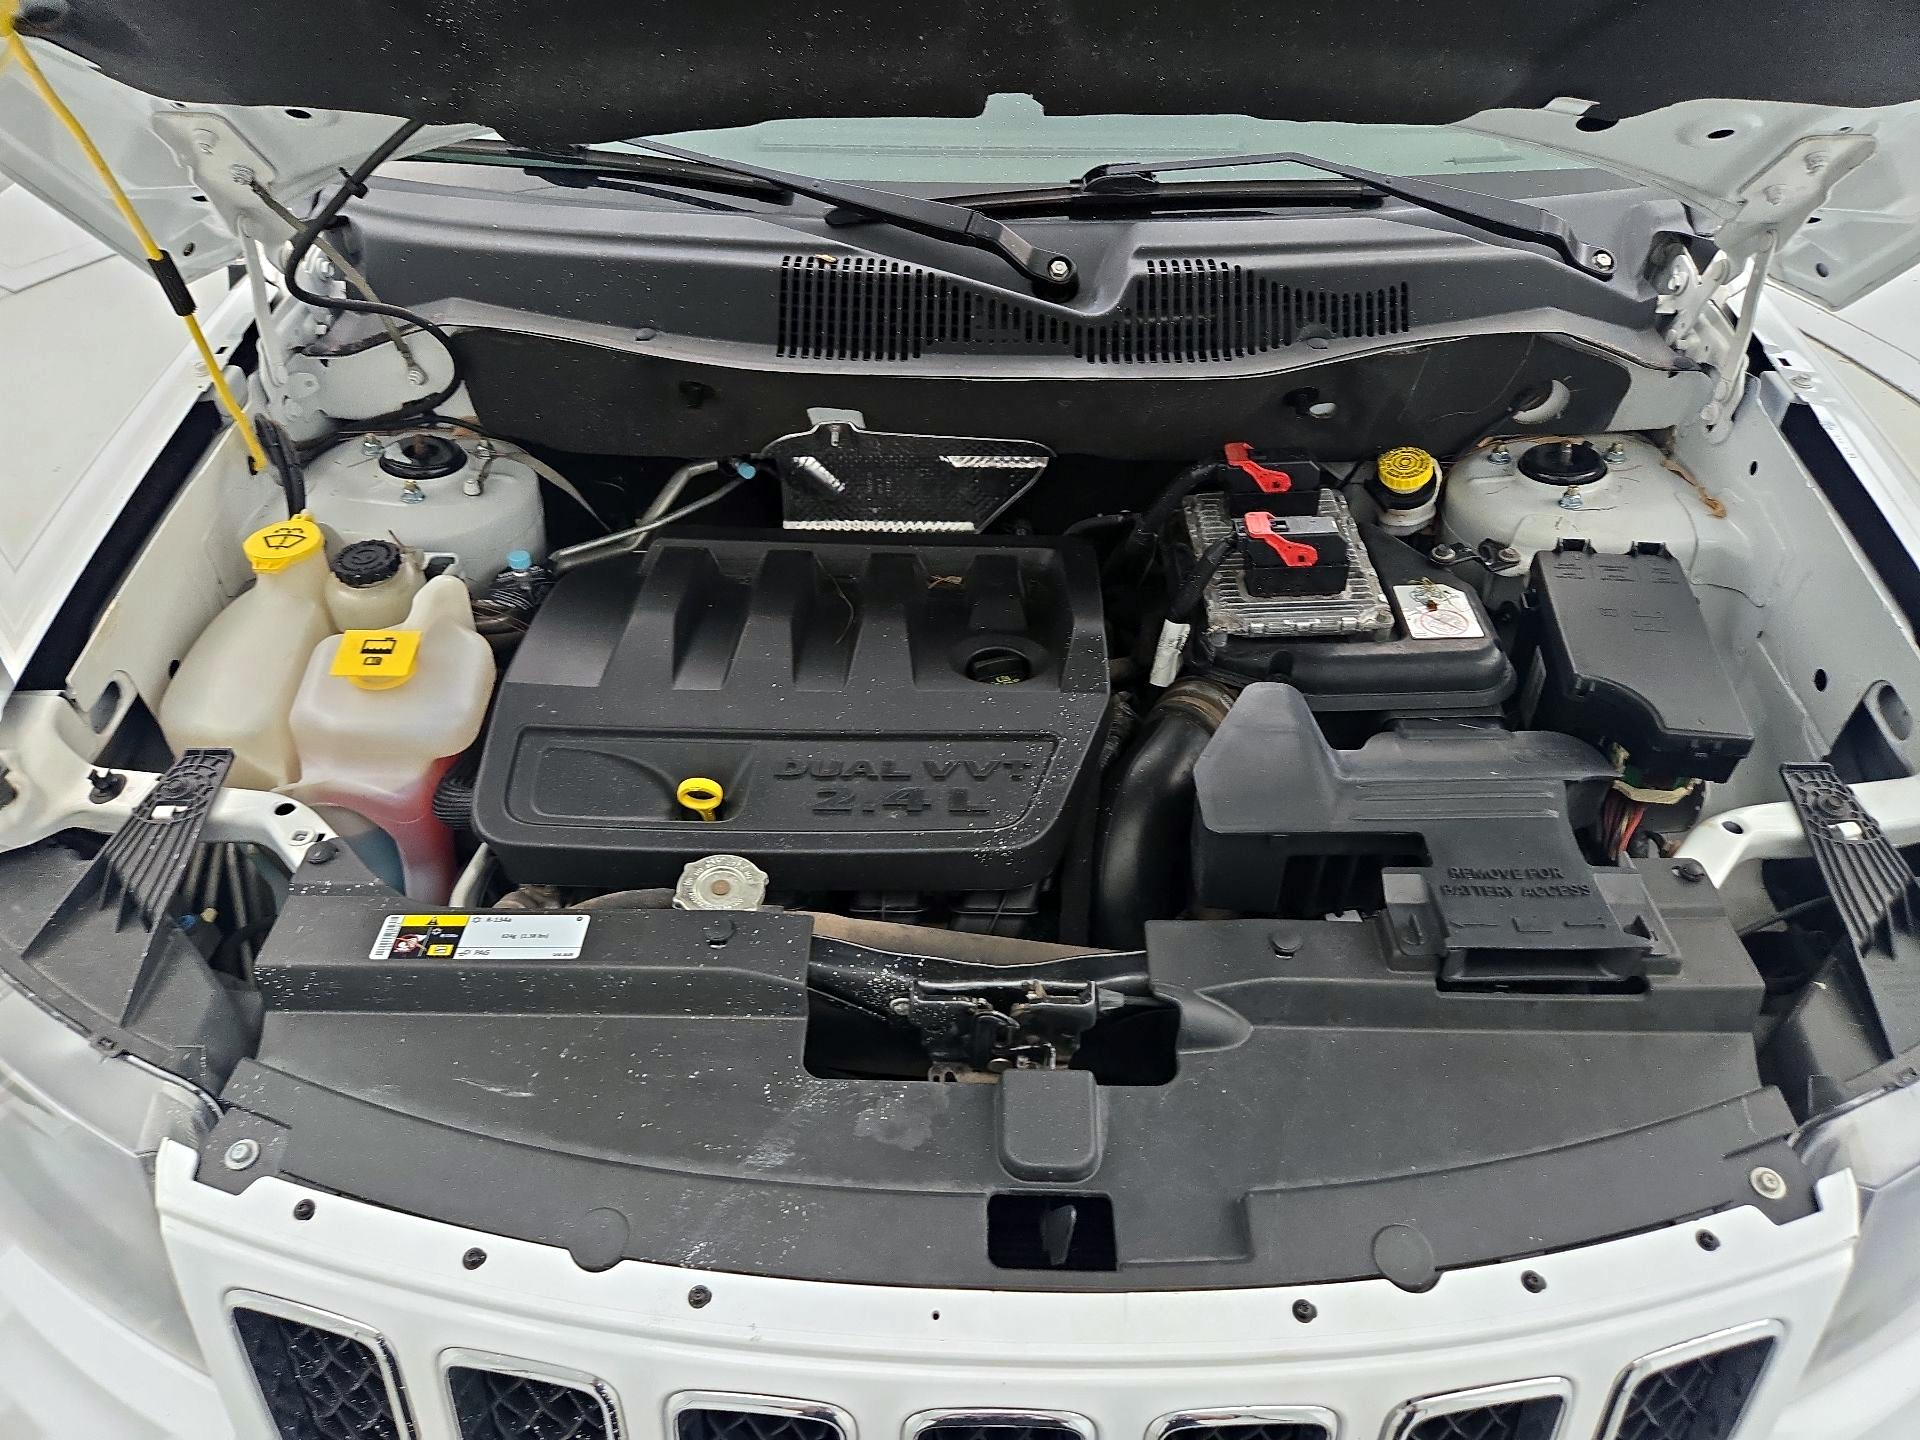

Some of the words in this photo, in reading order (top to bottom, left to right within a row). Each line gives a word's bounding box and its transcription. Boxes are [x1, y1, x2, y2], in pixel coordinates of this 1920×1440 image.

[773, 759, 912, 781] DUAL
[922, 759, 1032, 781] VVT
[1448, 867, 1523, 880] REMOVE
[1524, 867, 1566, 880] FOR
[1440, 885, 1514, 897] BATTERY
[1521, 885, 1591, 897] ACCESS
